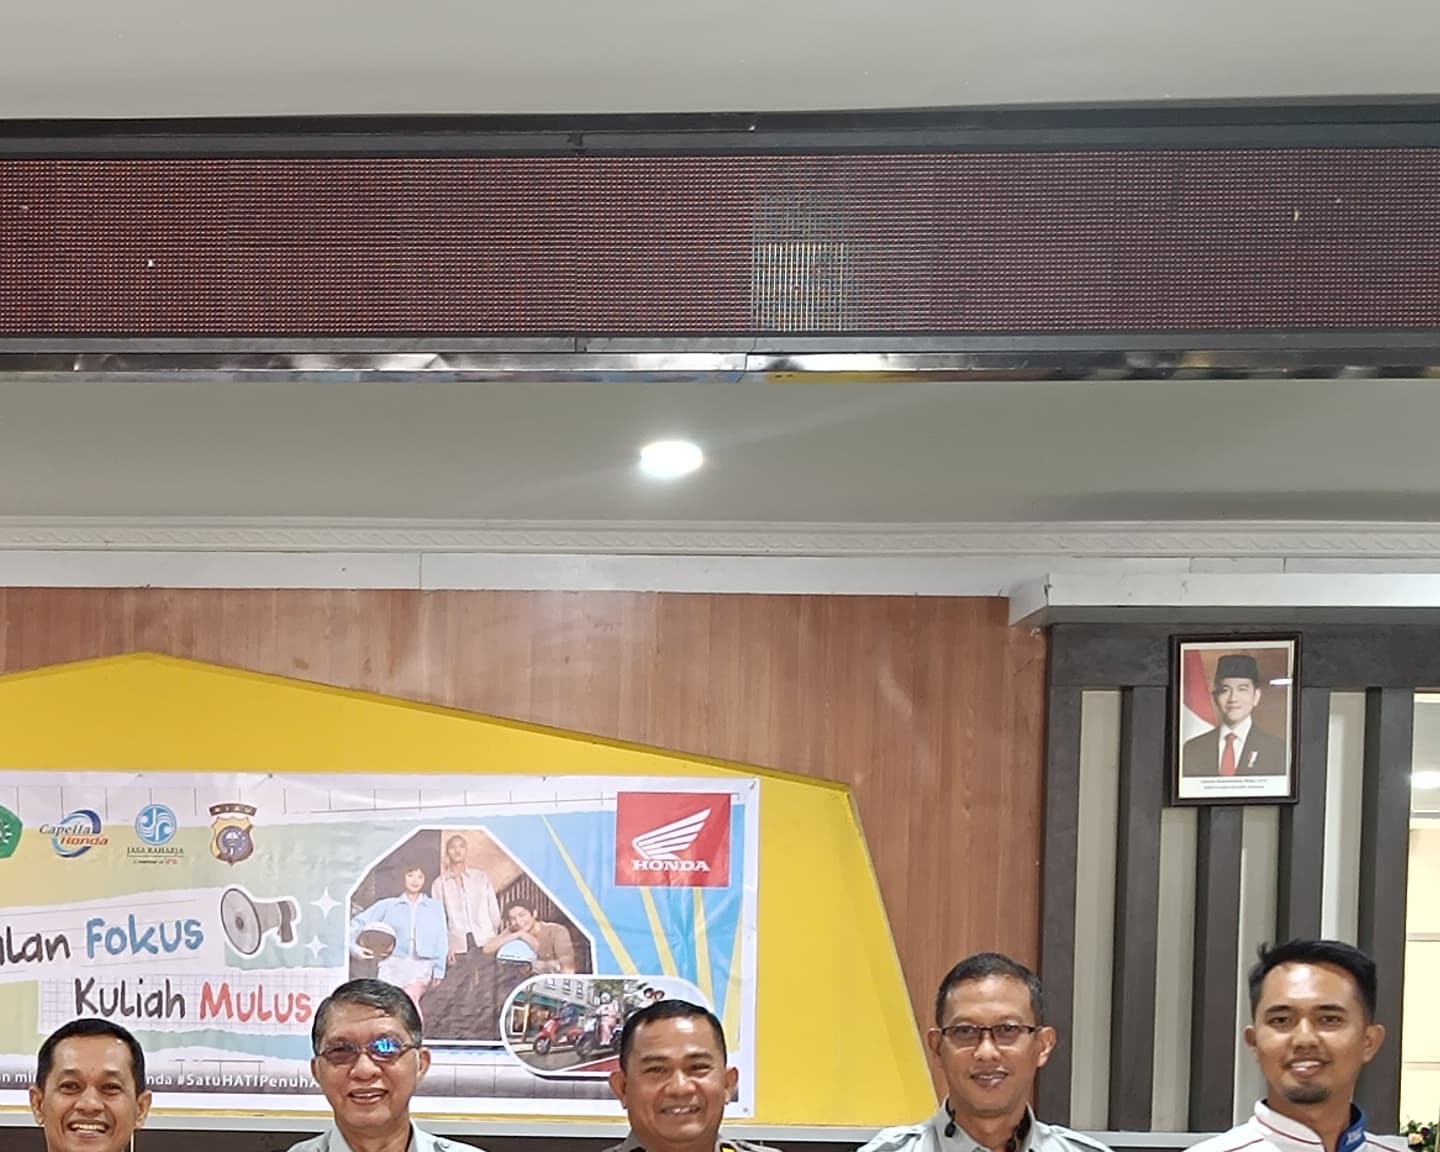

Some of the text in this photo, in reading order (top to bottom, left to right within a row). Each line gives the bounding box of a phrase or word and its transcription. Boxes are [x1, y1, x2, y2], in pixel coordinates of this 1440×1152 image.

[39, 821, 91, 836] Capella
[60, 835, 109, 847] Honda
[632, 859, 710, 872] HONDA
[85, 913, 205, 960] Fokus
[73, 977, 312, 1023] Kuliah Mulus
